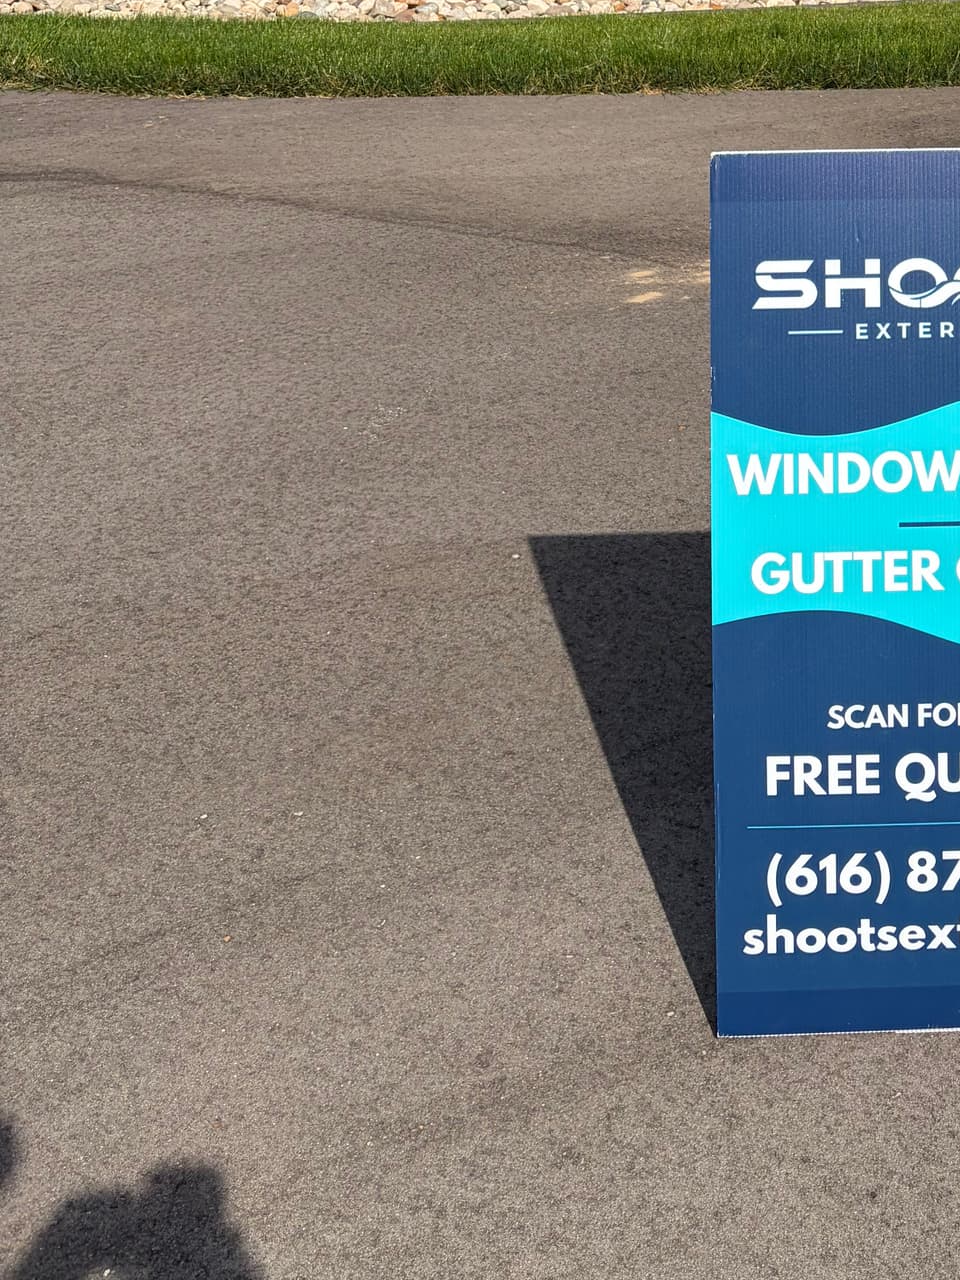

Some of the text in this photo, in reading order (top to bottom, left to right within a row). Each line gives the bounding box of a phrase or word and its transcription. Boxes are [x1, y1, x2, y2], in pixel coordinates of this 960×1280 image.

[751, 549, 945, 595] GUTTER
[827, 703, 909, 730] SCAN
[766, 754, 881, 796] FREE
[766, 850, 891, 908] (616)
